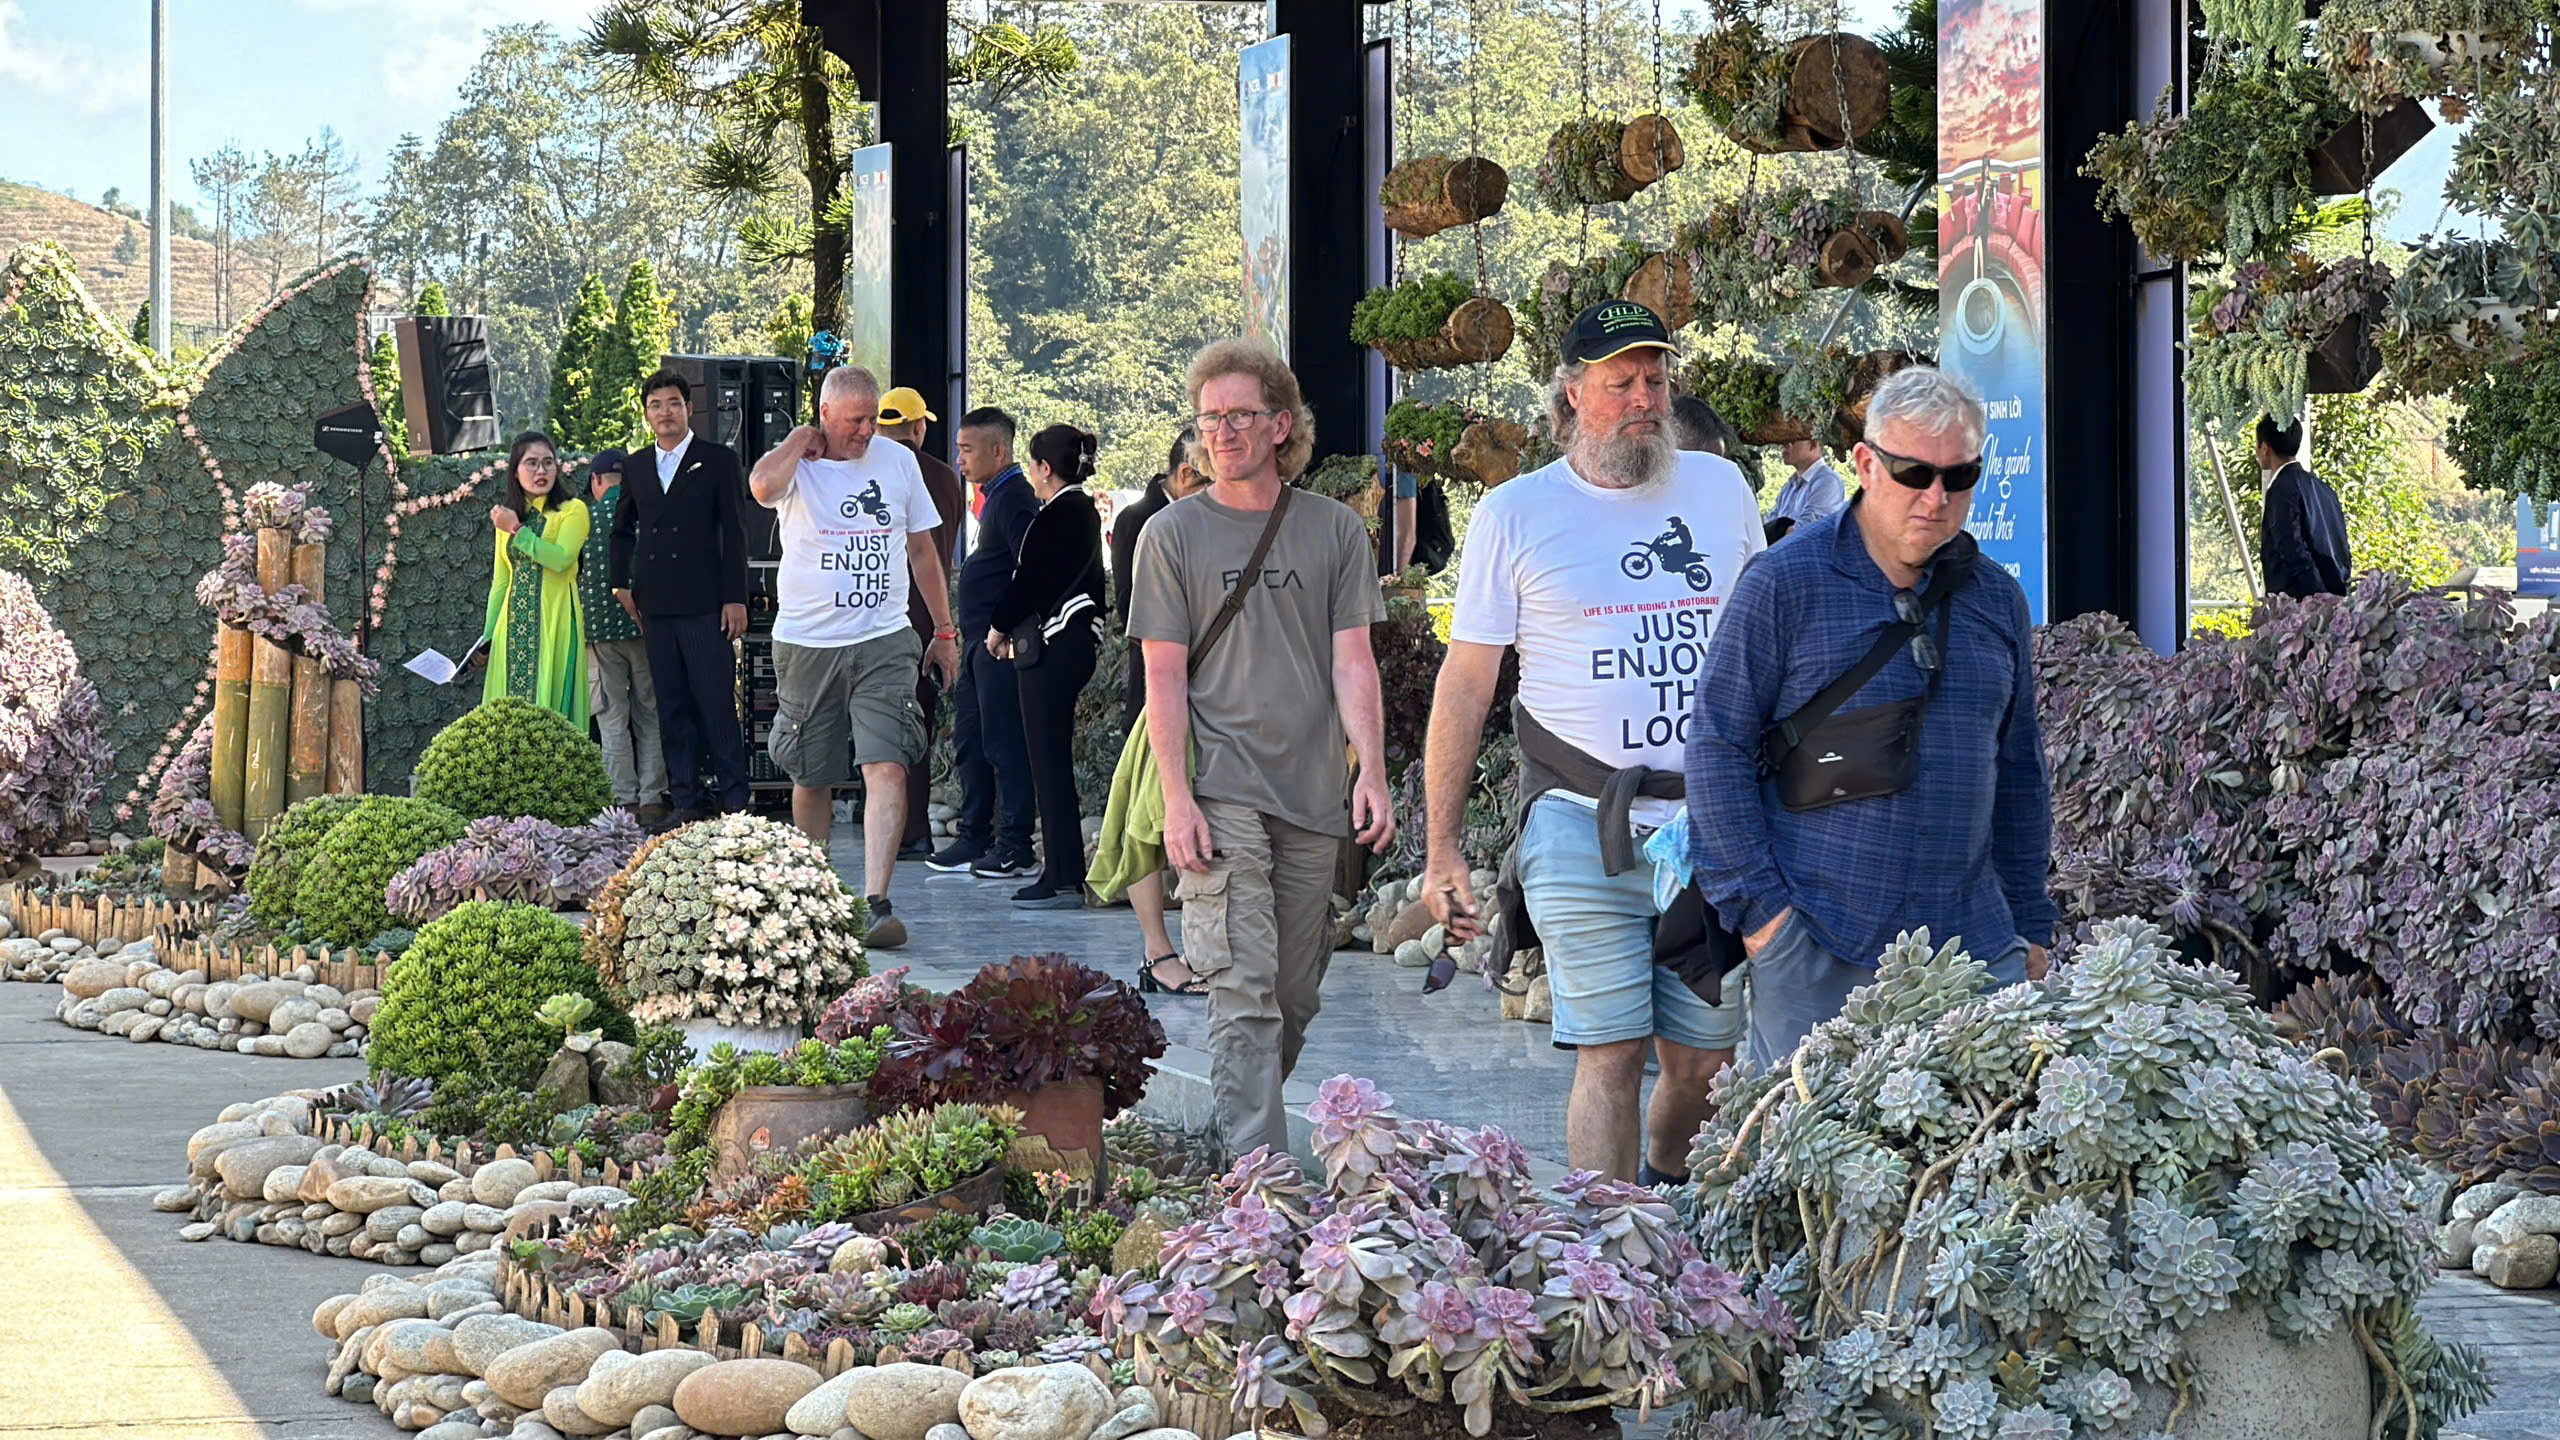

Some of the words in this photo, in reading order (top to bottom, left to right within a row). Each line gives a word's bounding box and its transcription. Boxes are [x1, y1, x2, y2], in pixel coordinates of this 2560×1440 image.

[1990, 400, 2008, 419] SINH
[845, 535, 889, 552] JUST
[820, 553, 890, 571] ENJOY
[852, 573, 890, 590] THE
[835, 591, 888, 609] LOOP
[1584, 607, 1602, 617] LIFE
[1604, 605, 1613, 615] IS
[1616, 604, 1635, 614] LIKE
[1638, 601, 1667, 612] RIDING
[1669, 600, 1676, 609] A
[1678, 596, 1720, 607] MOTORBIKE
[1633, 609, 1713, 644] JUST
[1650, 679, 1698, 712] TH
[1622, 713, 1692, 750] LOO
